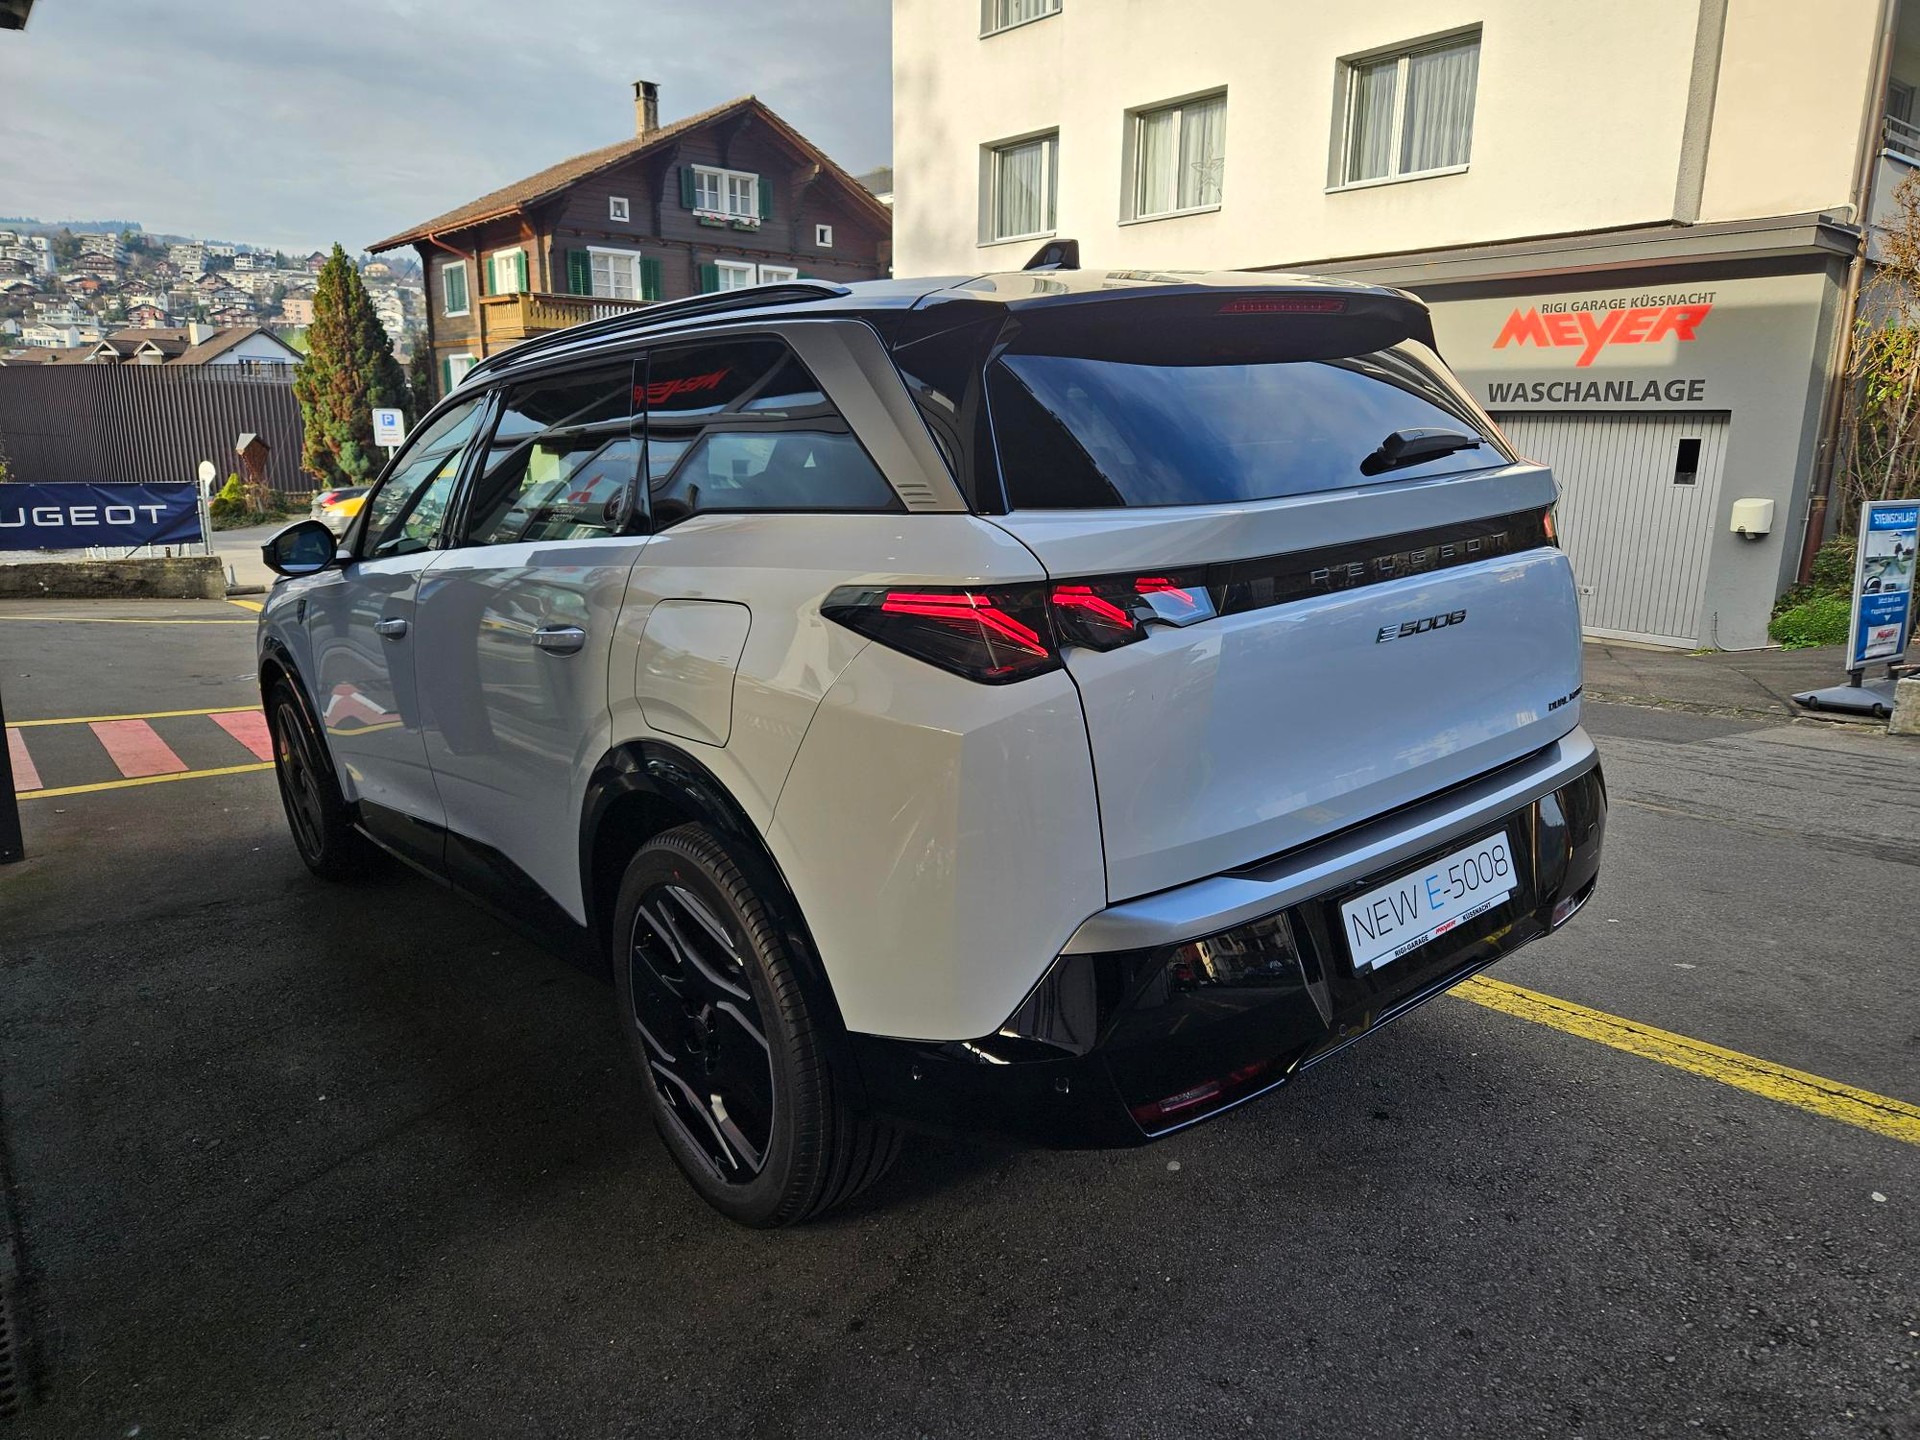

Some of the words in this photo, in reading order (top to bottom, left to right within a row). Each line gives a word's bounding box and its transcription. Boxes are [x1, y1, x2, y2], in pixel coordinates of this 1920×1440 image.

[1541, 302, 1567, 314] RIGI
[1571, 298, 1626, 312] GARAGE
[1630, 292, 1716, 308] KÜSSNACHT
[1492, 304, 1713, 367] MEYER
[1488, 379, 1706, 403] WASCHANLAGE
[1310, 531, 1508, 585] PEUGEOT
[1352, 884, 1418, 947] NEW
[1425, 845, 1508, 911] E-5008
[1394, 935, 1429, 957] RIGI-GARAGE
